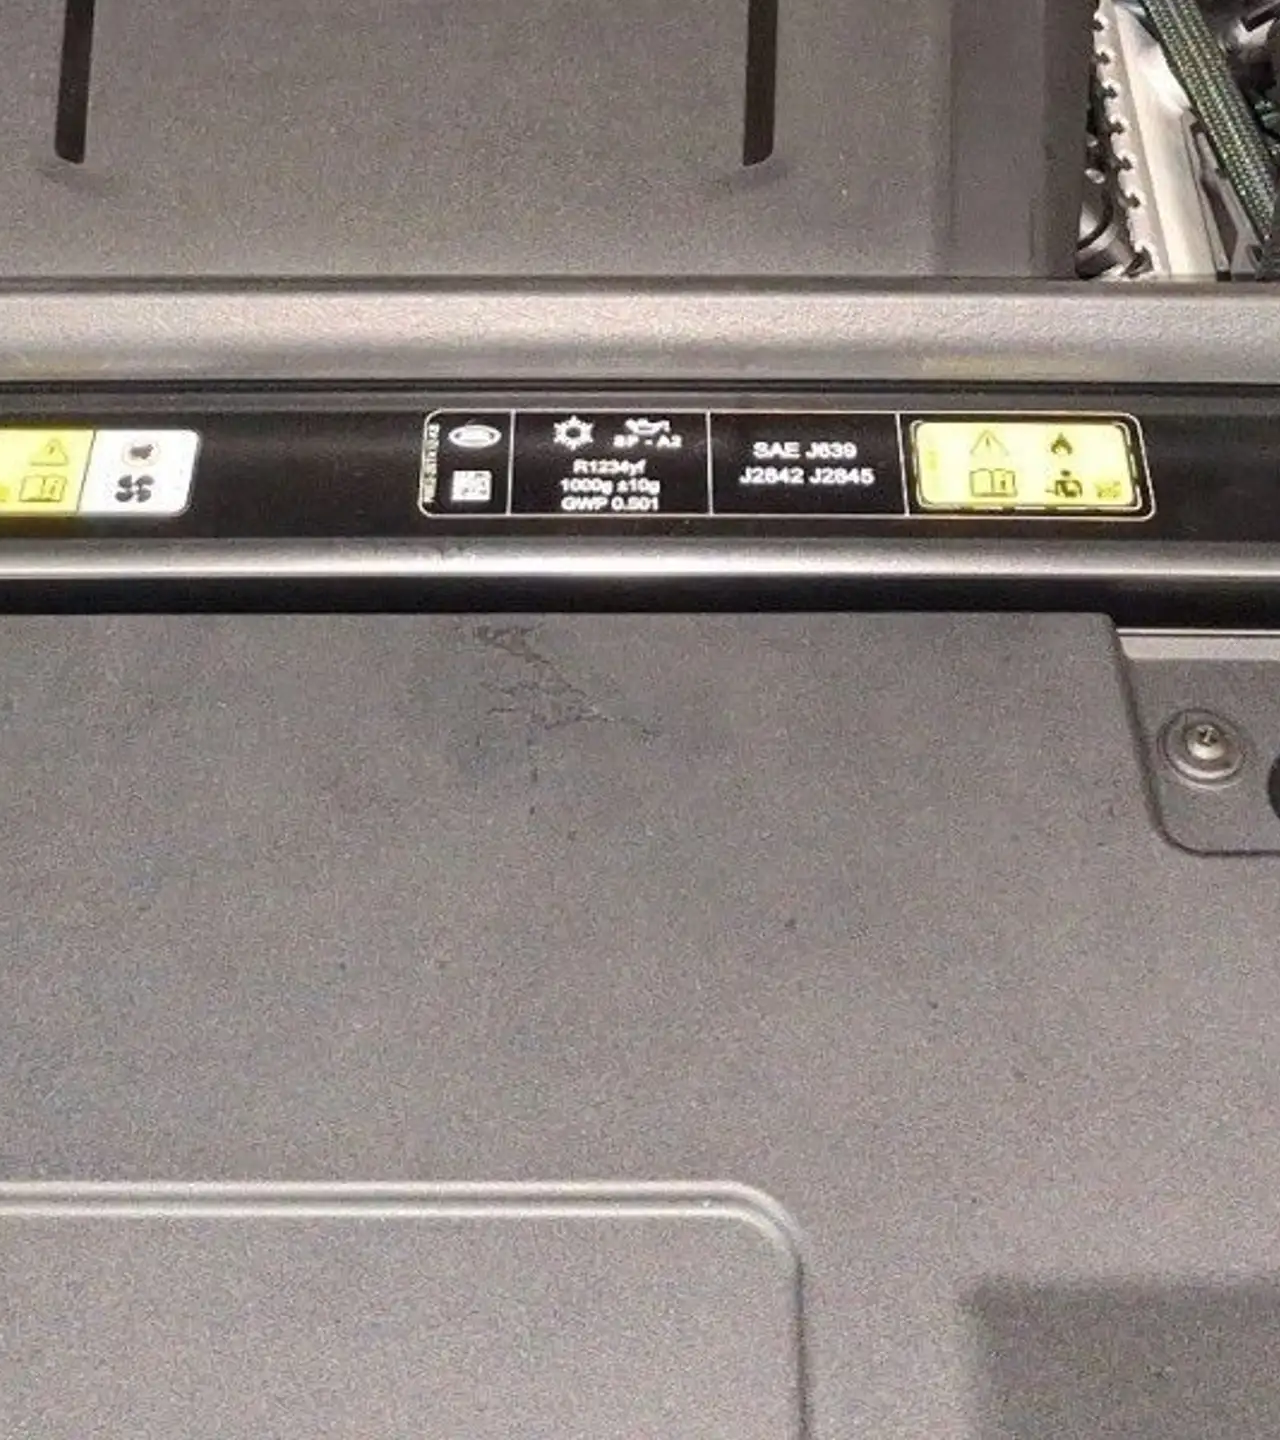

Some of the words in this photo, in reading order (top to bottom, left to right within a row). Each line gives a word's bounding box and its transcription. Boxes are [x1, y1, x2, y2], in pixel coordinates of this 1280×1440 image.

[753, 441, 801, 459] SAE
[805, 441, 858, 459] J639
[573, 458, 647, 476] R1234yf
[560, 477, 614, 495] 1000g
[560, 495, 609, 511] GWP
